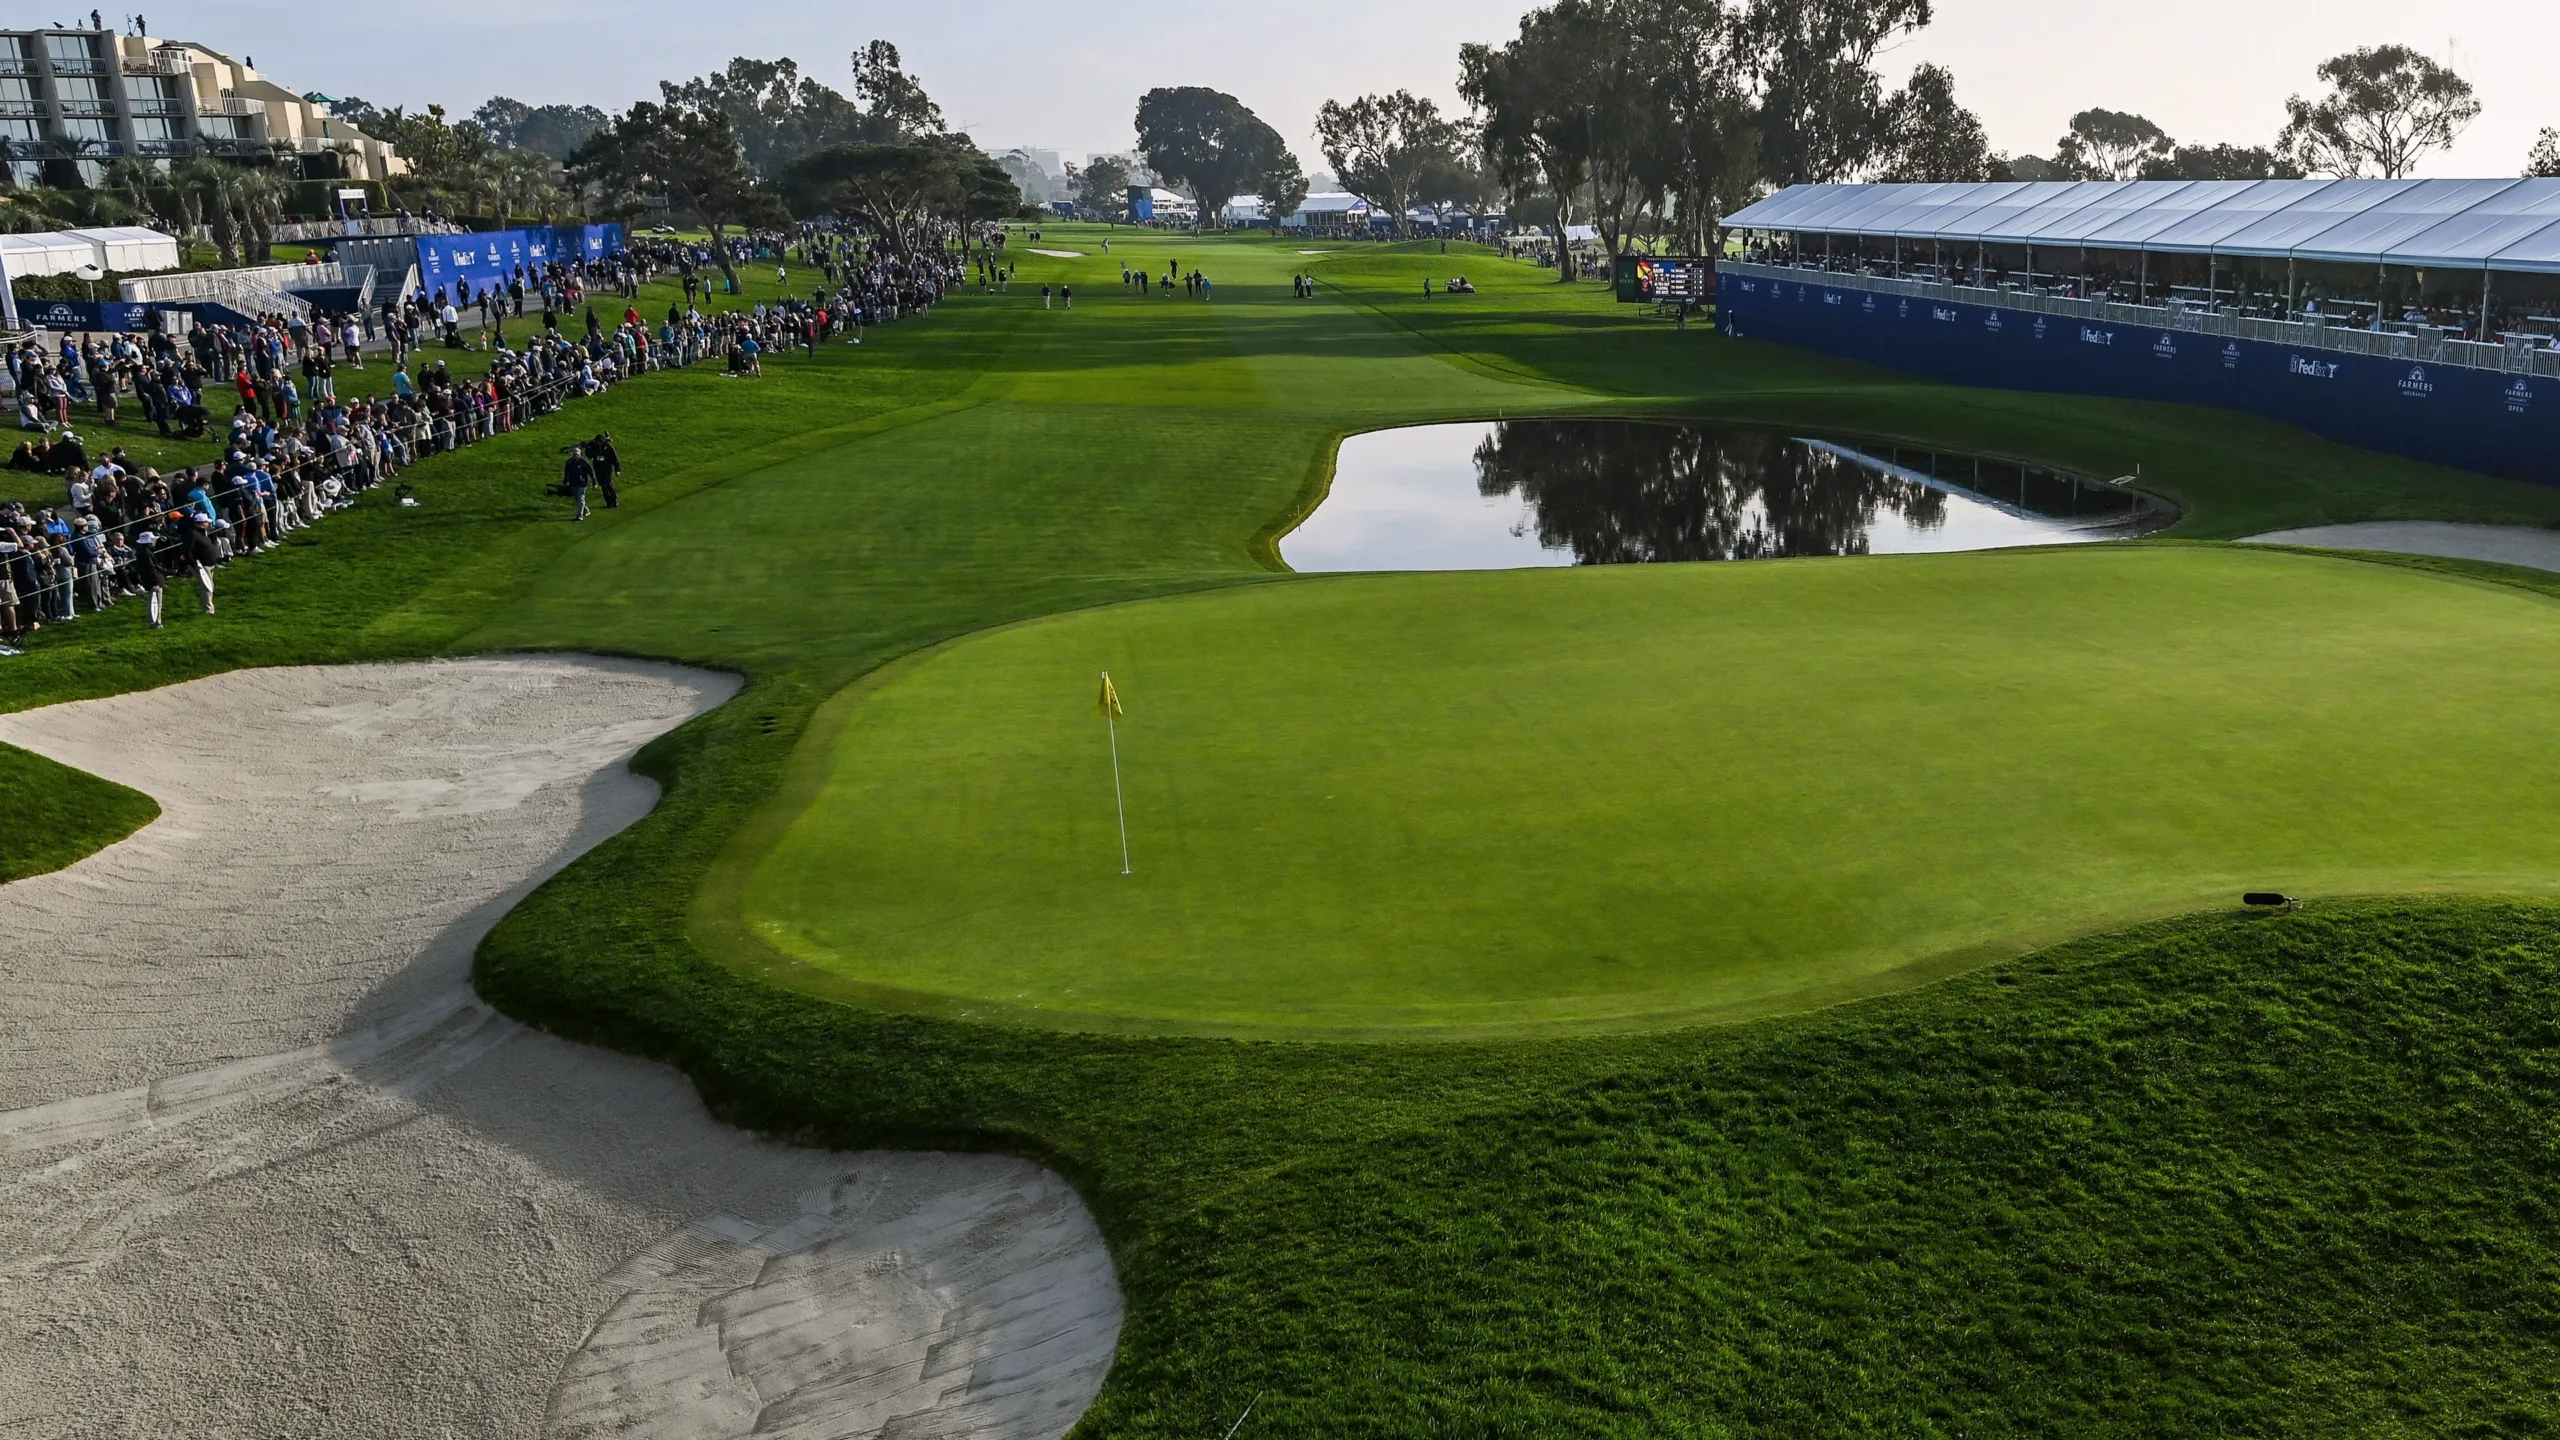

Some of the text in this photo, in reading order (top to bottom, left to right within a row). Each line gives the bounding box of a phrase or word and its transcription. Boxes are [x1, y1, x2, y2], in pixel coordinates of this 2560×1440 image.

[36, 314, 87, 322] FARMERS
[2152, 343, 2177, 354] FARMERS
[2298, 358, 2327, 377] FedEx
[2397, 379, 2434, 392] FARMERS
[2505, 388, 2532, 398] FARMERS
